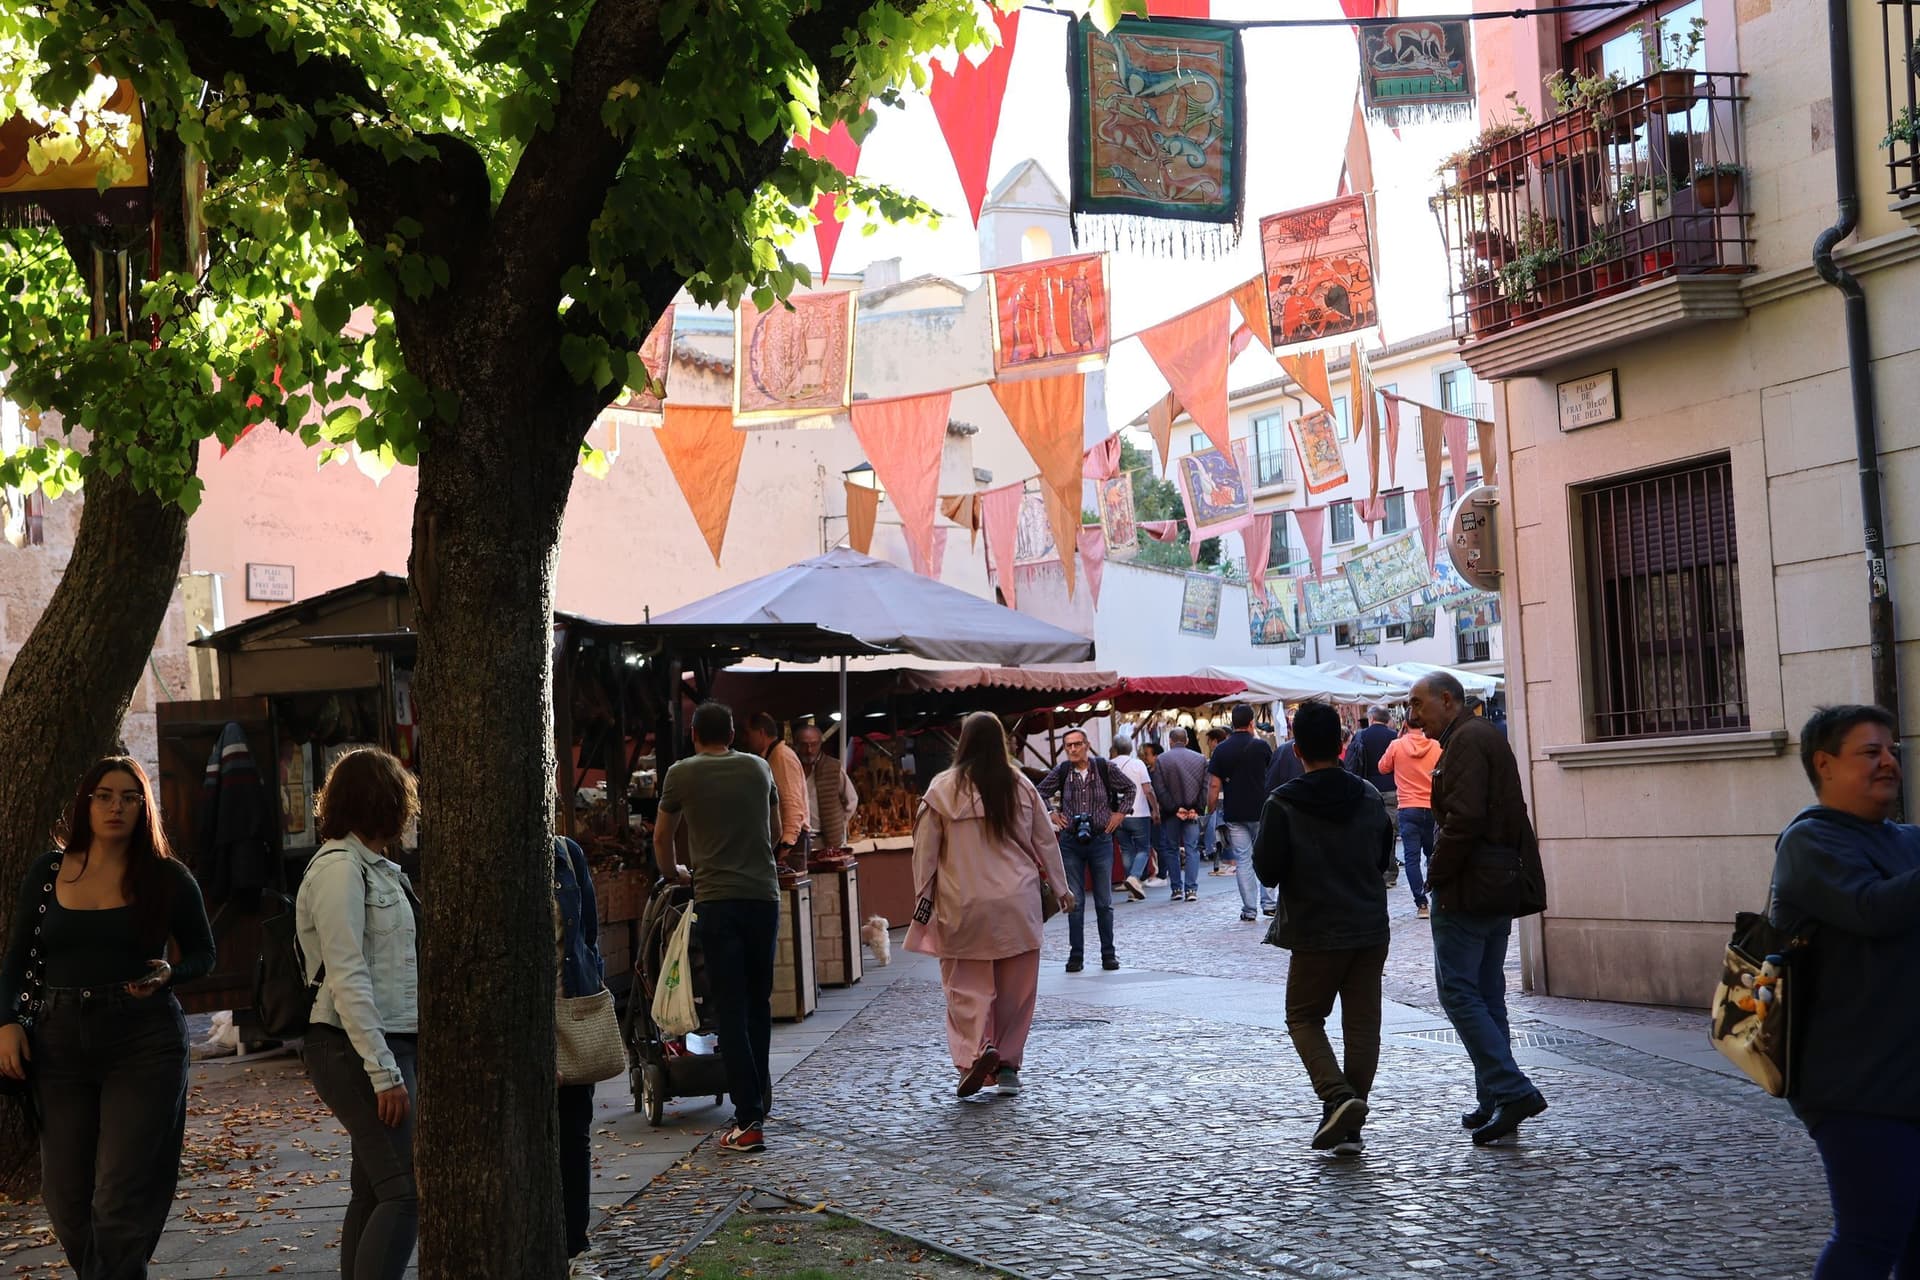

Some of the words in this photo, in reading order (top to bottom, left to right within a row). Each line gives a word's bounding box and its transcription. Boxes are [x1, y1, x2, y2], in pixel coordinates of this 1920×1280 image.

[1576, 381, 1597, 393] PLAZA
[1581, 392, 1590, 401] DE
[1566, 404, 1582, 415] FRAY
[1572, 413, 1581, 423] DE
[1585, 409, 1602, 419] DEZA
